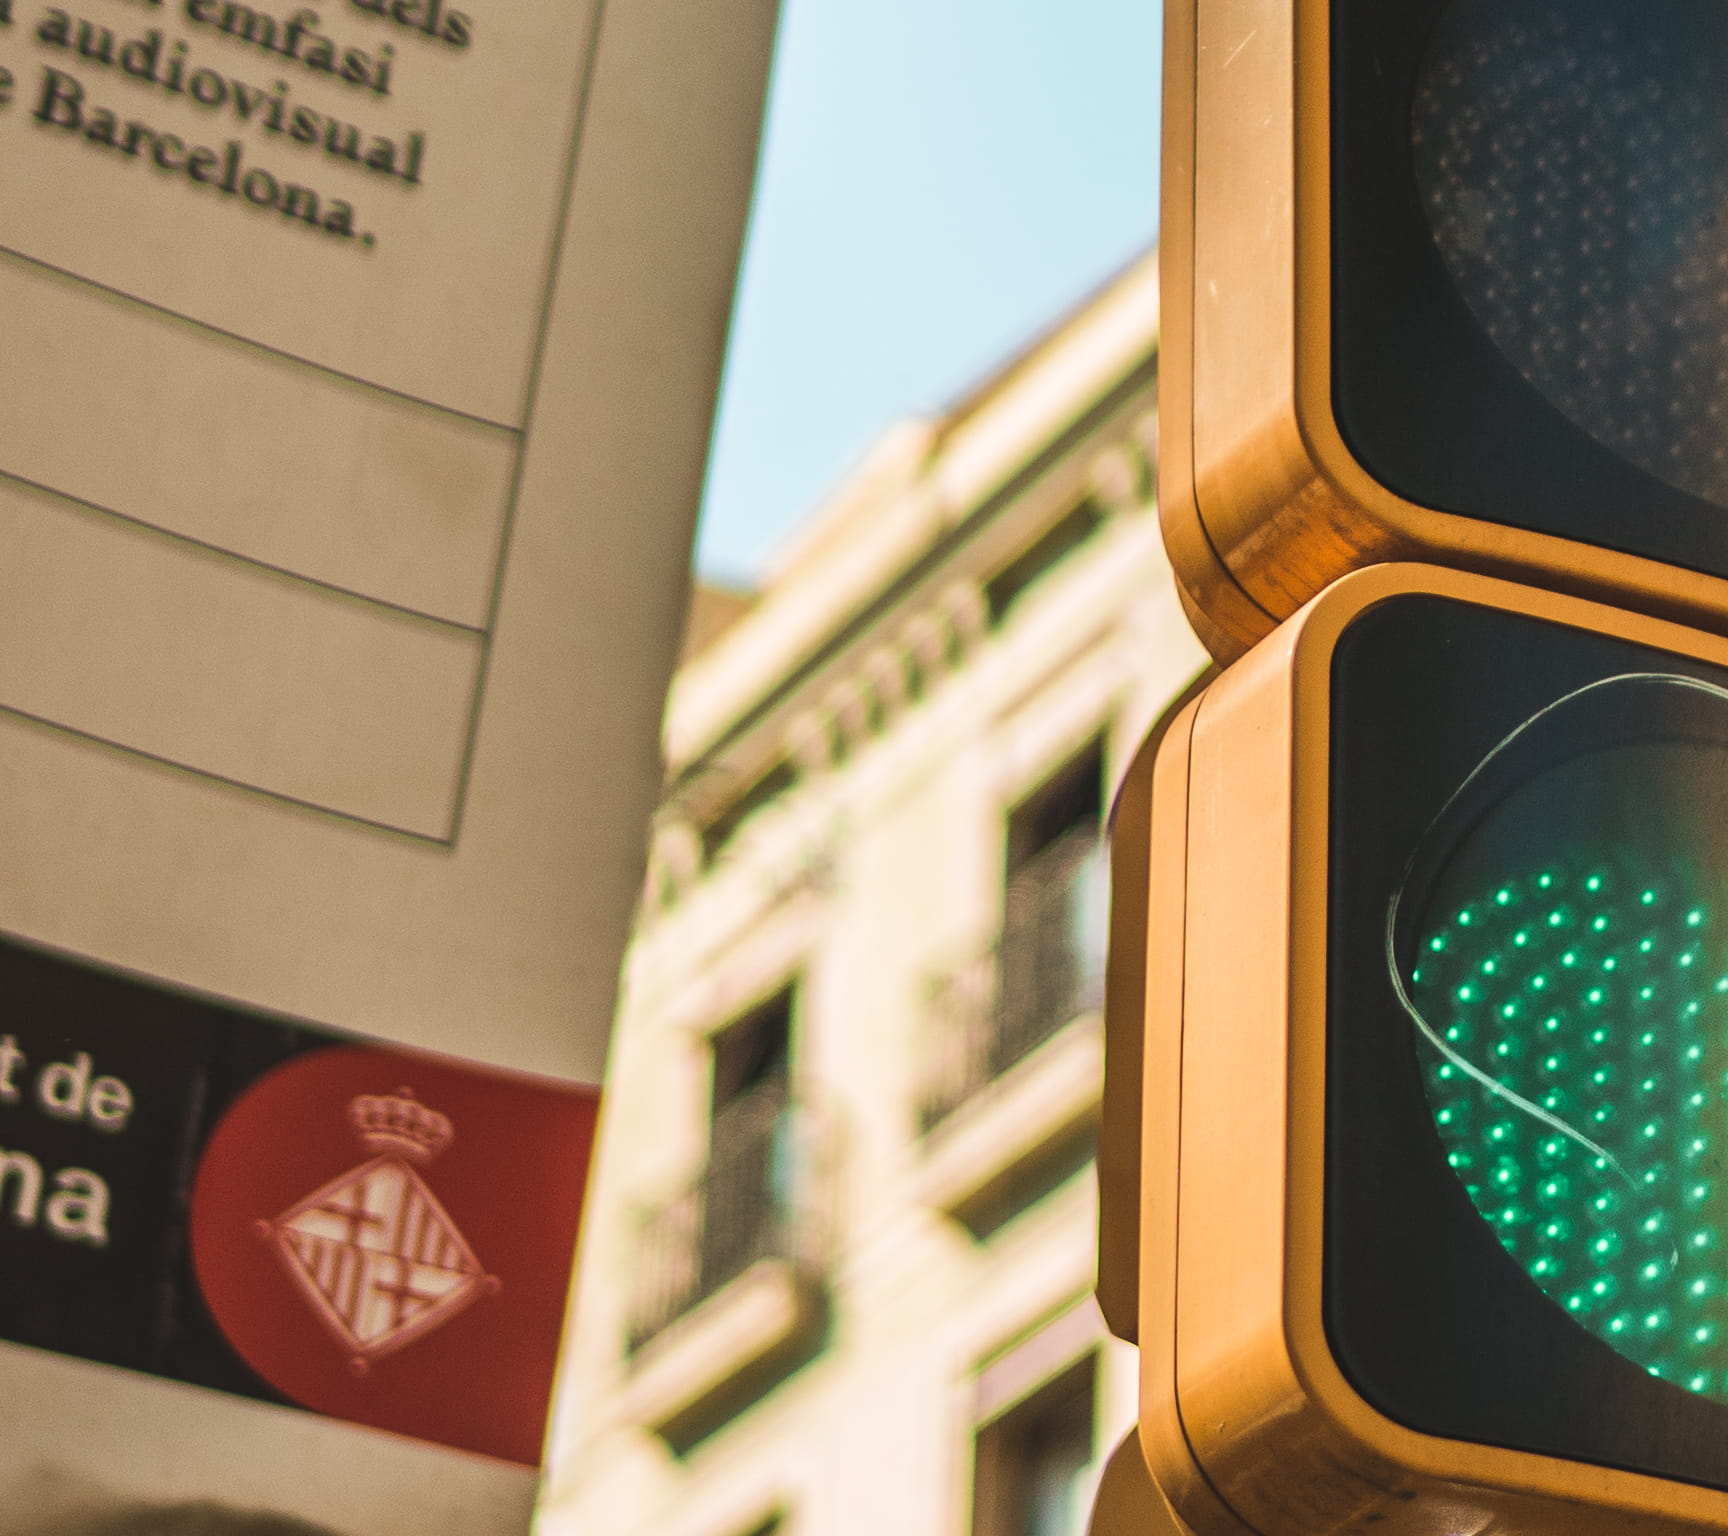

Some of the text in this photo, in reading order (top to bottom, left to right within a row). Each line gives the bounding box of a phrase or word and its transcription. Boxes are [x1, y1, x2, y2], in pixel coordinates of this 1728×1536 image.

[32, 66, 377, 255] Barcelona.
[35, 8, 425, 195] audiovisual
[38, 1050, 133, 1131] de
[0, 1148, 110, 1245] na
